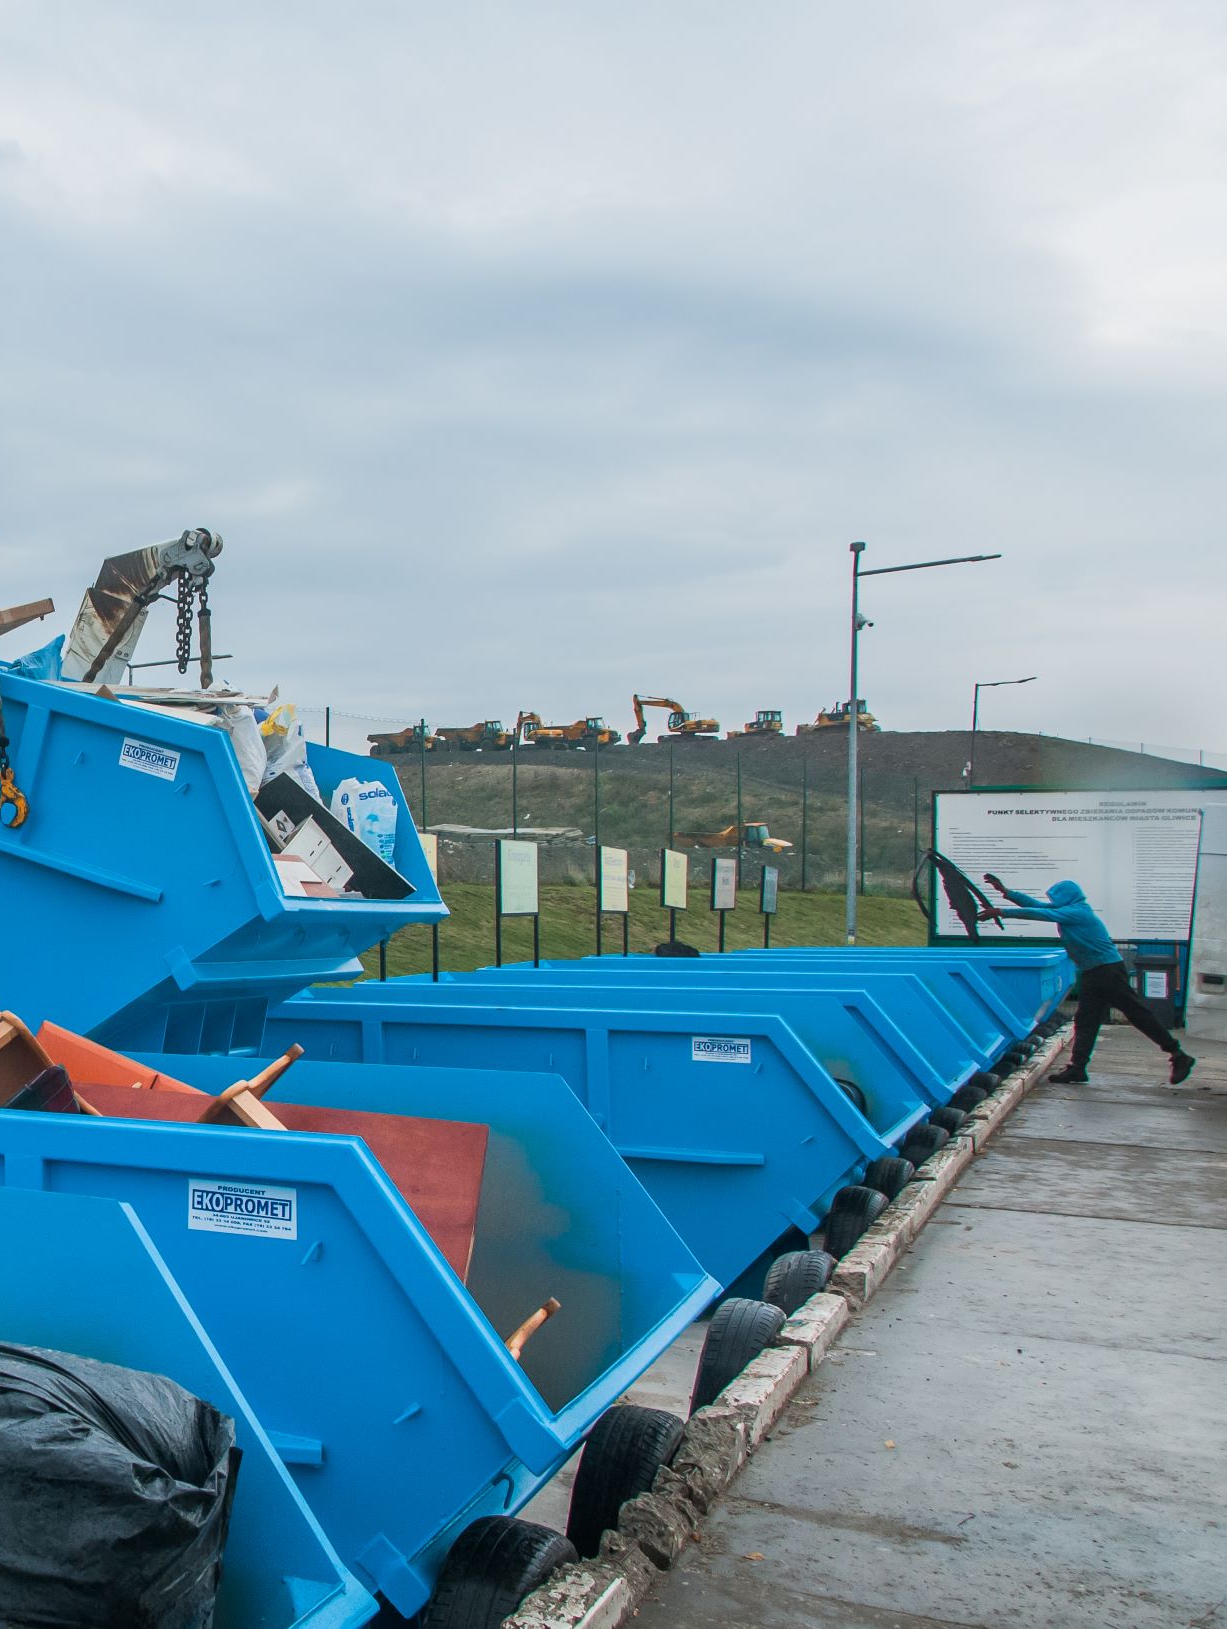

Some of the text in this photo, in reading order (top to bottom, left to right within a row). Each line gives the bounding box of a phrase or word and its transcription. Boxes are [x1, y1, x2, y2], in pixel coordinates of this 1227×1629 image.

[123, 744, 176, 769] EKOPROMET
[694, 1041, 747, 1054] EKOPROMET
[217, 1185, 267, 1196] PRODUCENT
[193, 1191, 289, 1218] EKOPROMET
